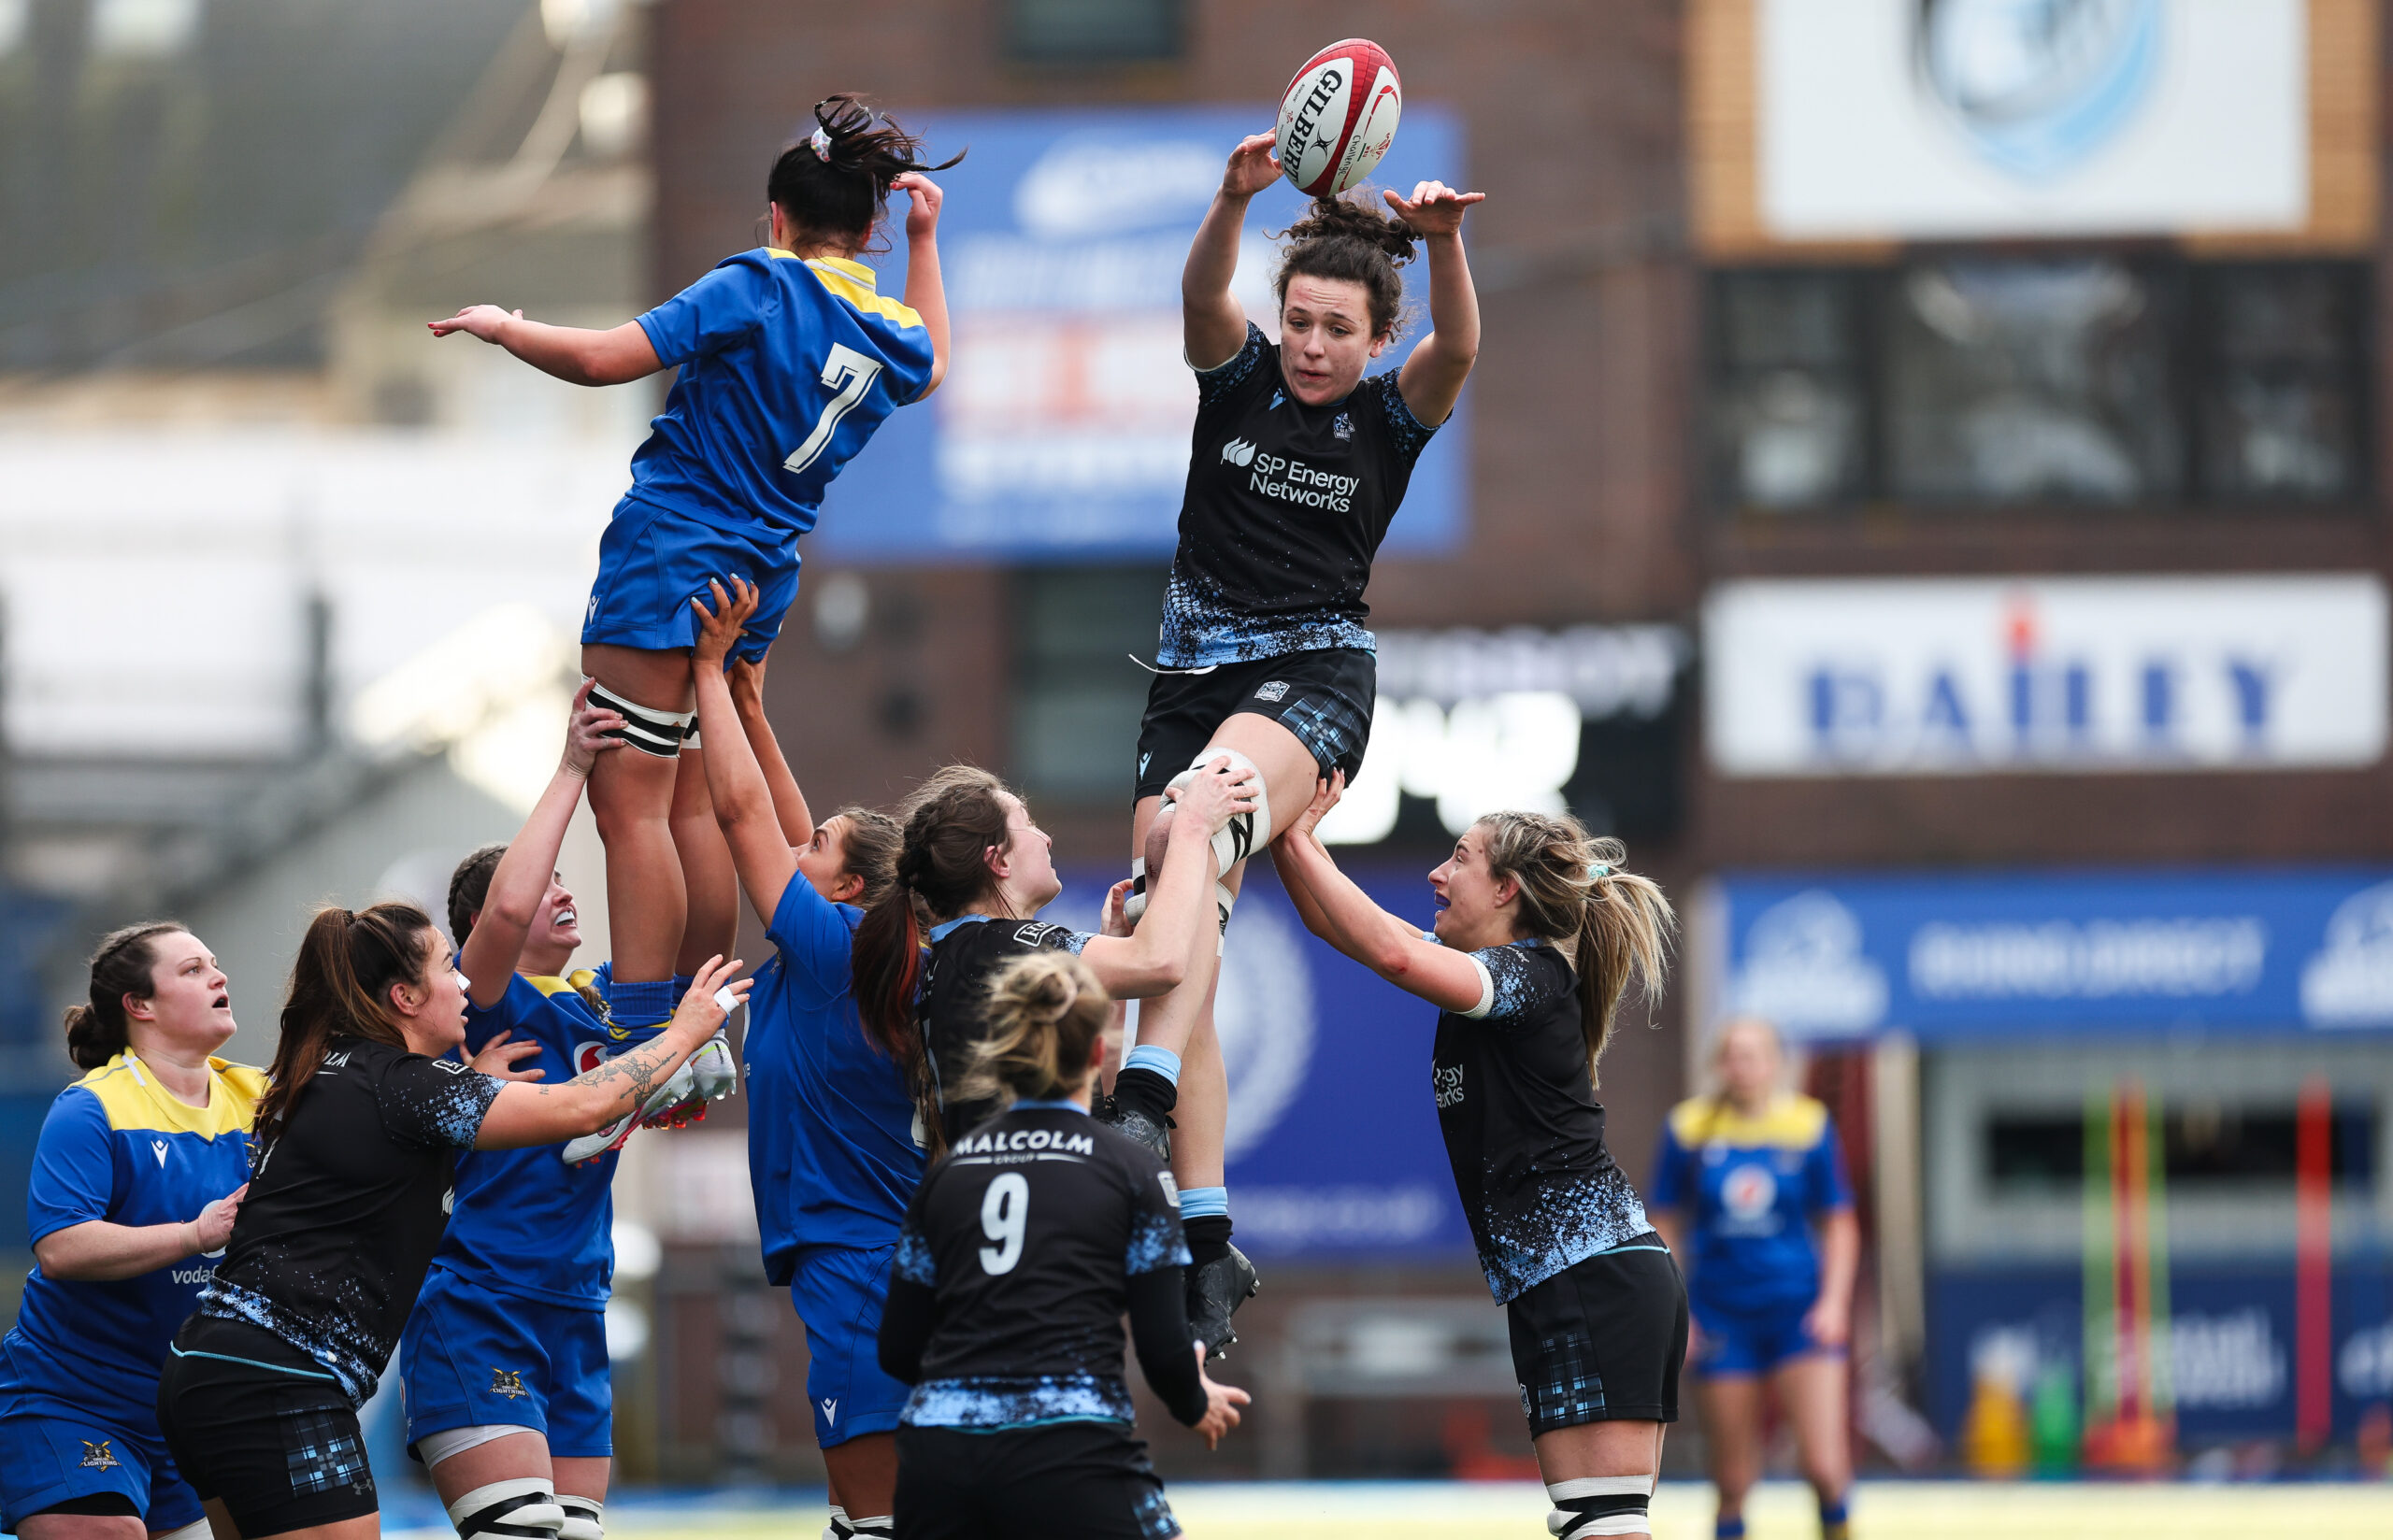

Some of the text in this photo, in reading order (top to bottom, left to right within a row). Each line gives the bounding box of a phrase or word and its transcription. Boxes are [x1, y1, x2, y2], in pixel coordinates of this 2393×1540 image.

[1283, 69, 1343, 184] GILBERT
[1338, 135, 1362, 176] Challenge
[782, 341, 884, 475] 7
[1249, 471, 1351, 513] Networks
[1254, 452, 1360, 497] SP Energy
[953, 1130, 1094, 1156] MALCOLM
[979, 1171, 1029, 1276] 9
